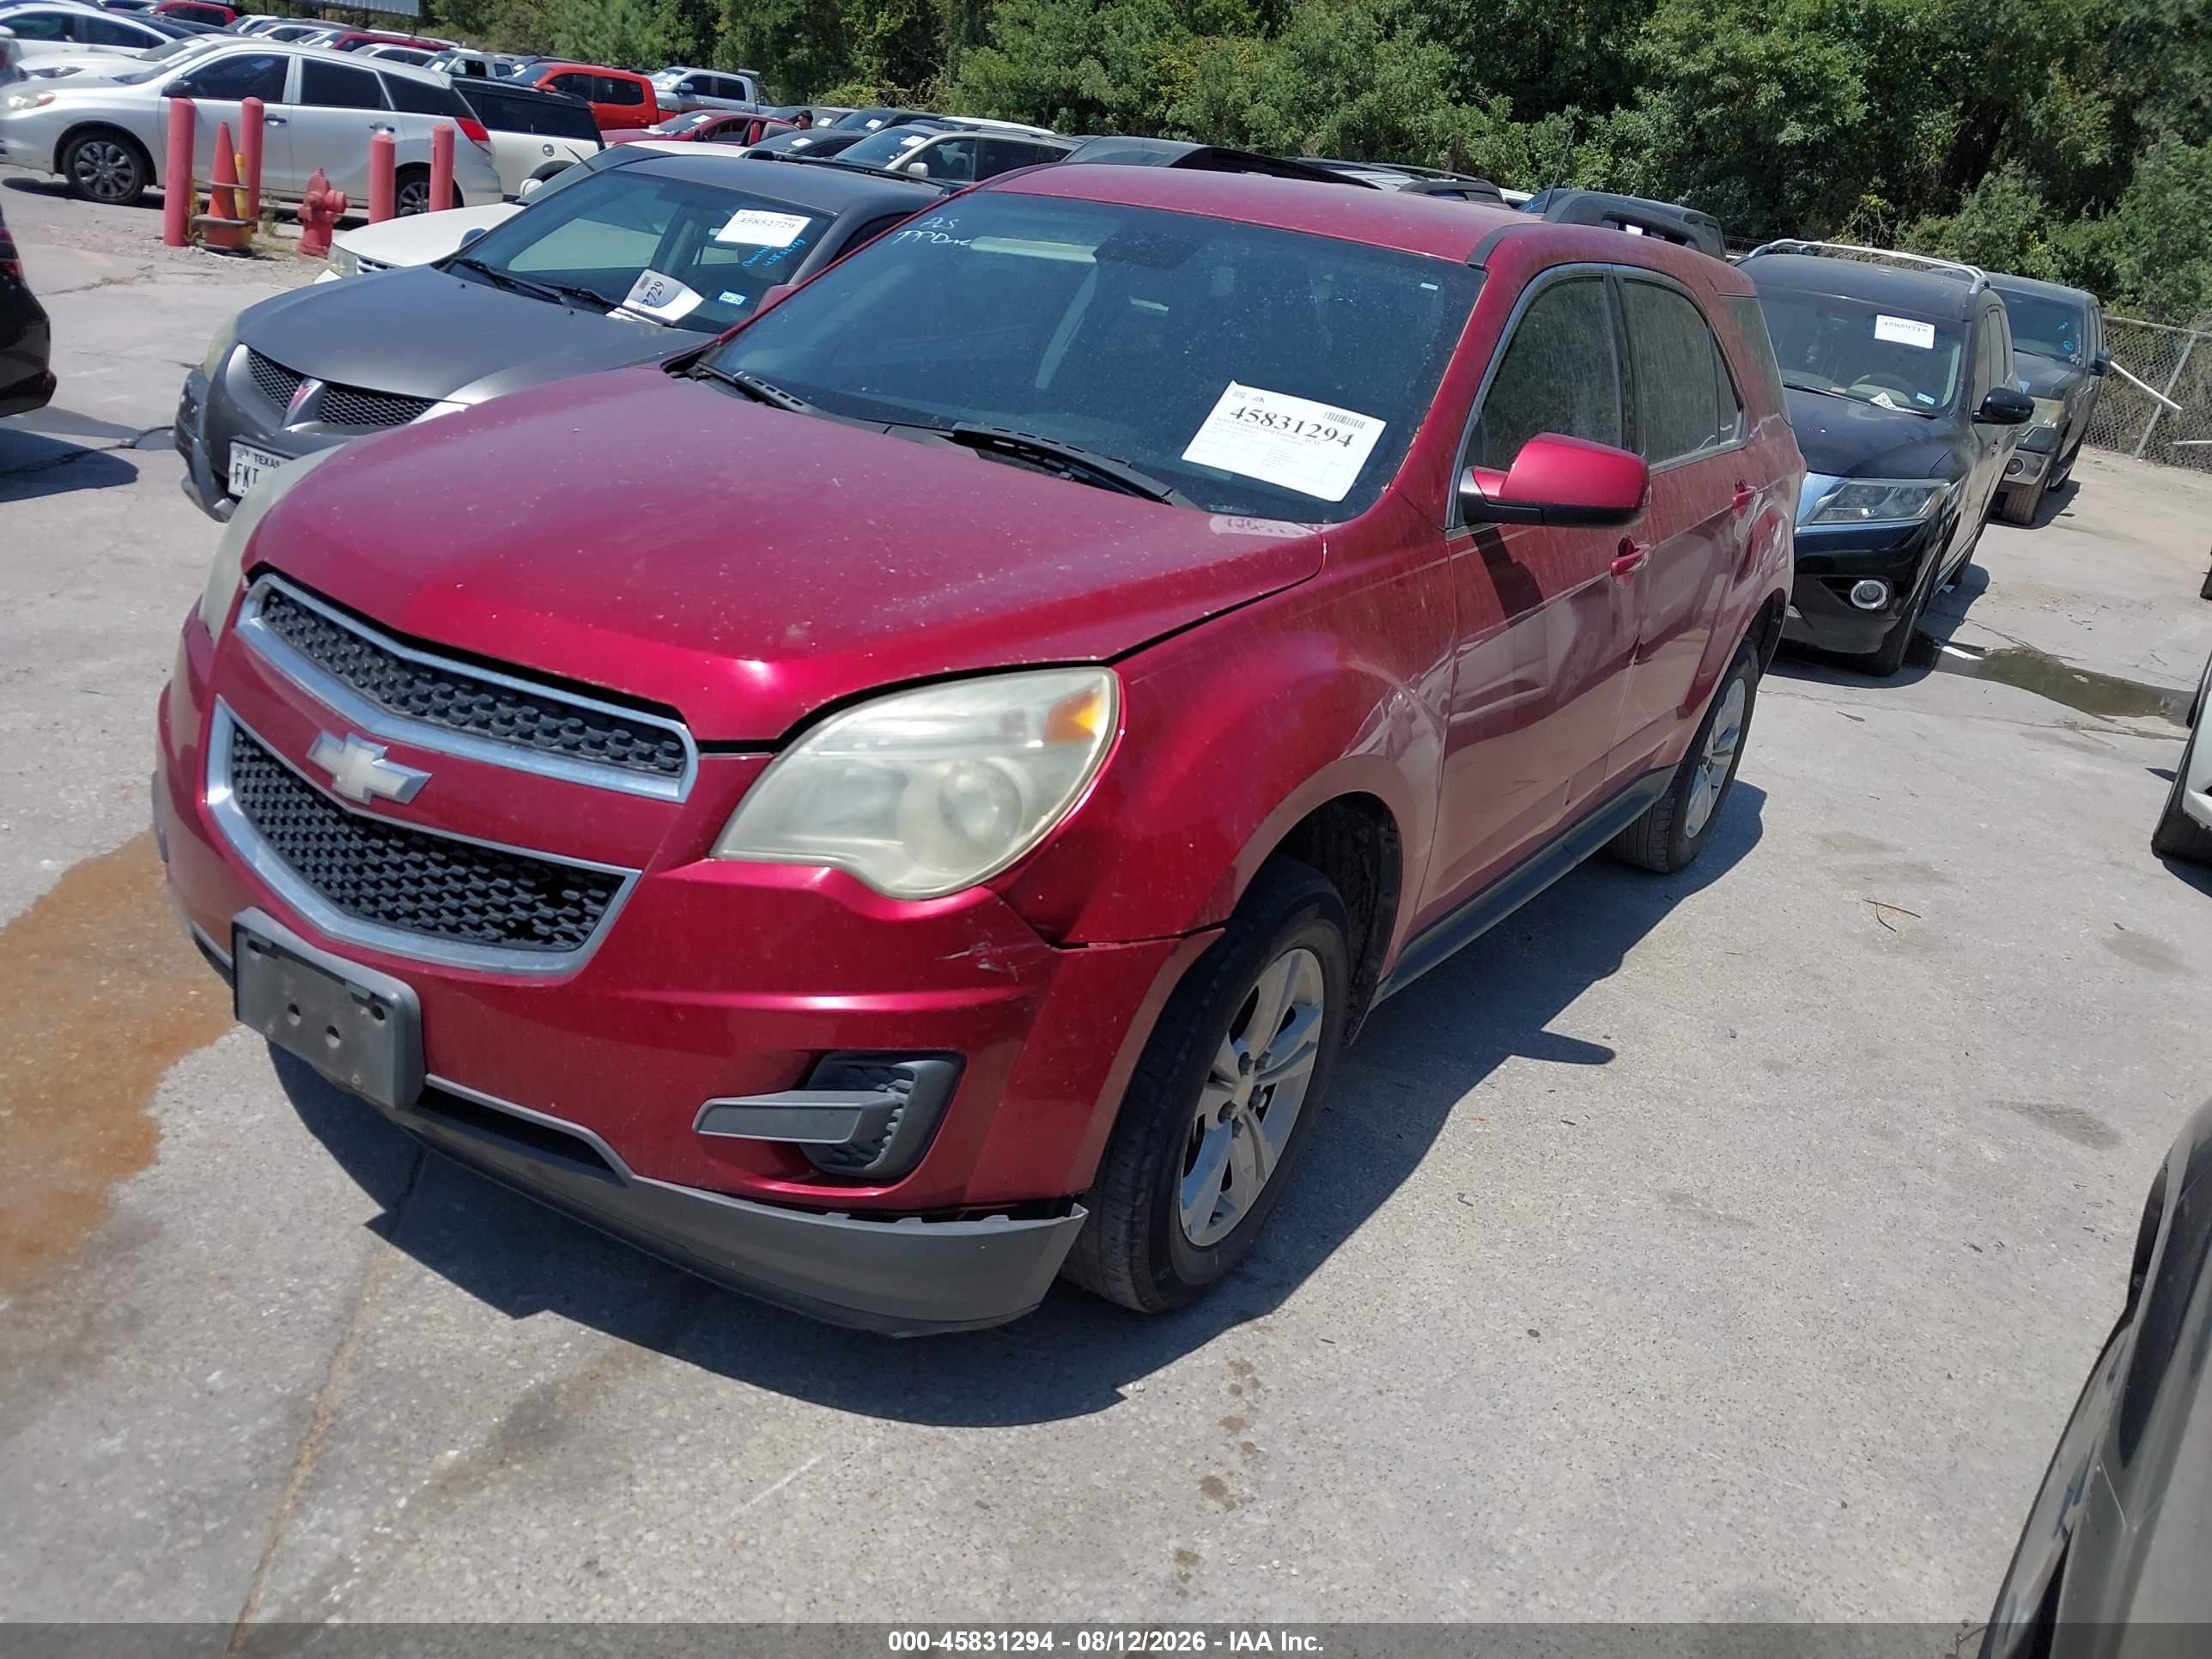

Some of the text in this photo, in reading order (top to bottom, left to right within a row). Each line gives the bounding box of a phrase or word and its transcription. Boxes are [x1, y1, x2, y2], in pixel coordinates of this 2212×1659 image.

[1230, 406, 1354, 448] 45831294
[253, 453, 281, 468] TEXAS
[234, 463, 259, 488] FKT
